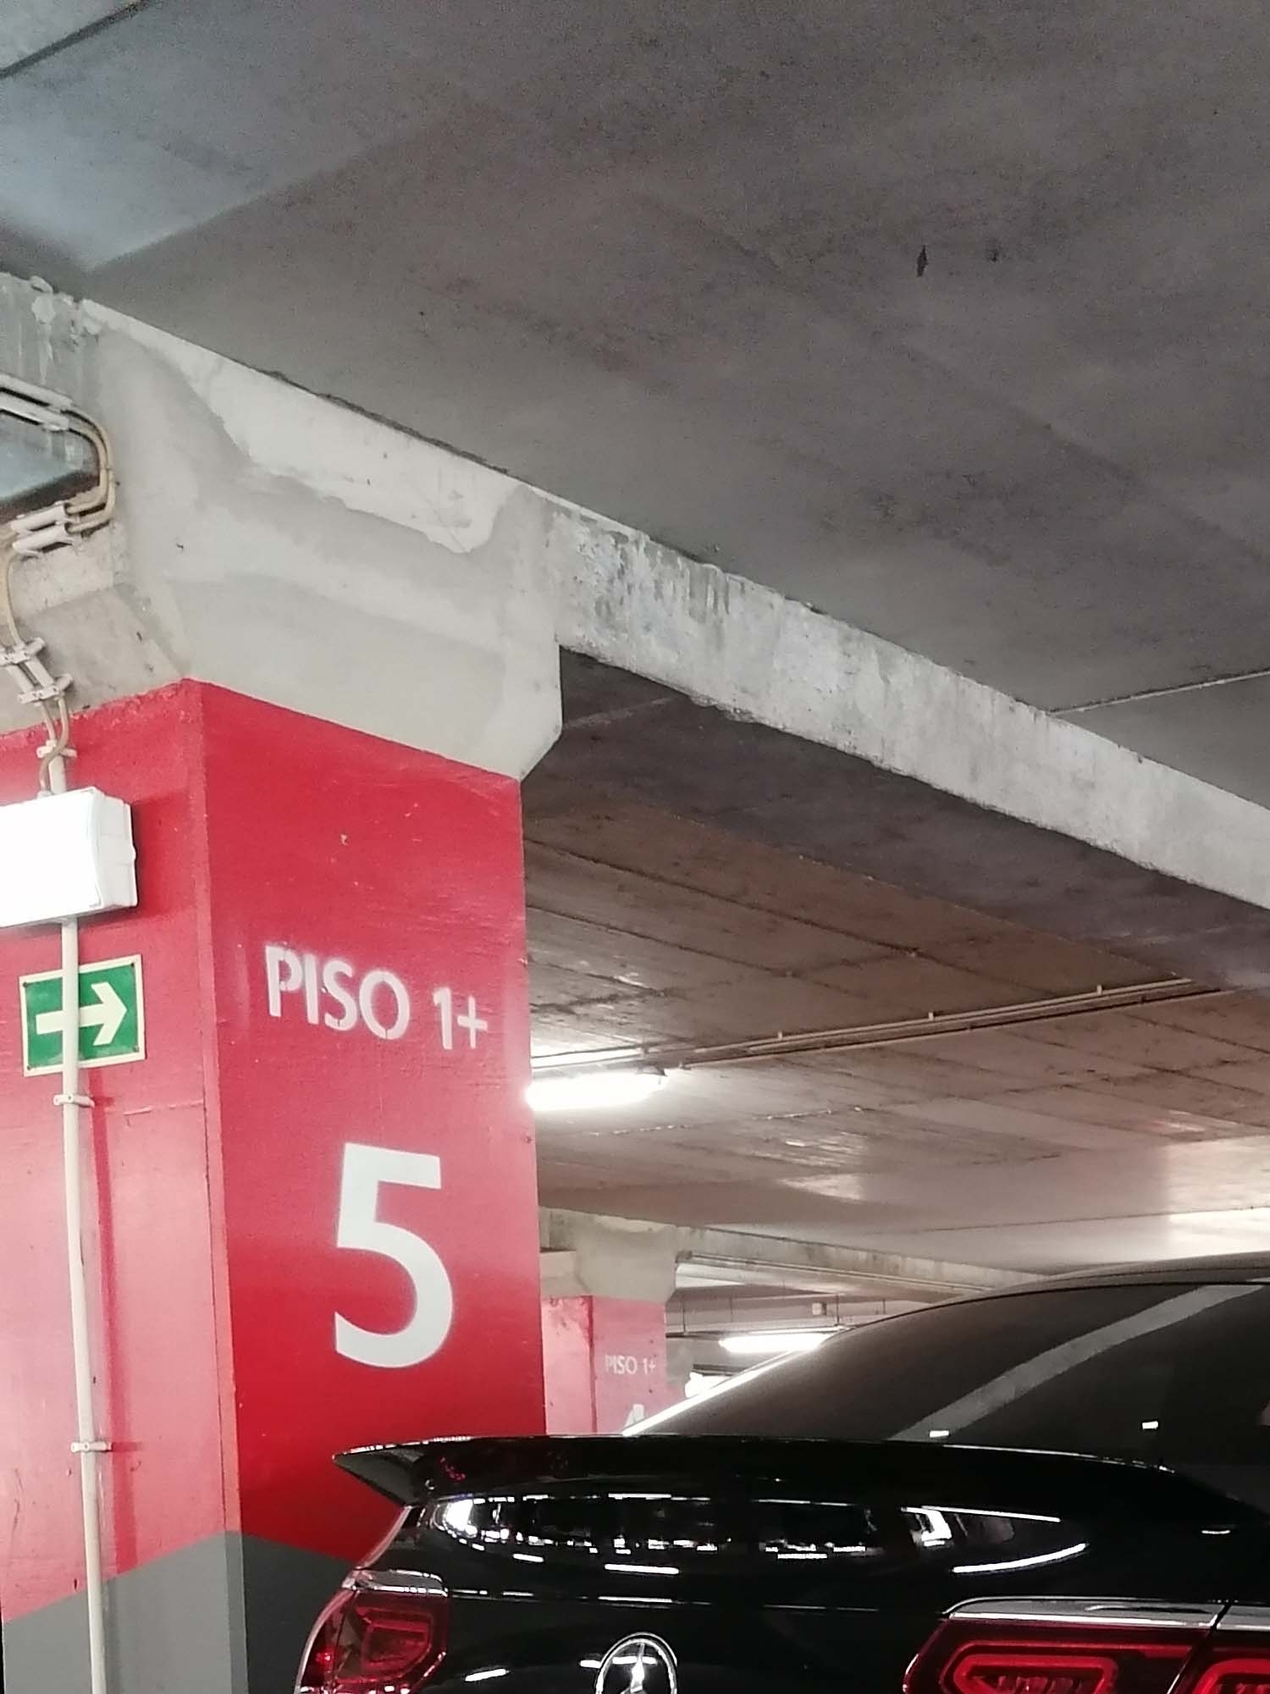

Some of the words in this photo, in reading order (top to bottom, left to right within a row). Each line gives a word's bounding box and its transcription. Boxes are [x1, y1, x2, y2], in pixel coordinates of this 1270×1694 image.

[264, 944, 411, 1041] PISO
[432, 986, 489, 1050] 1+
[334, 1140, 455, 1368] 5
[604, 1354, 638, 1376] PISO
[643, 1358, 657, 1376] 1+
